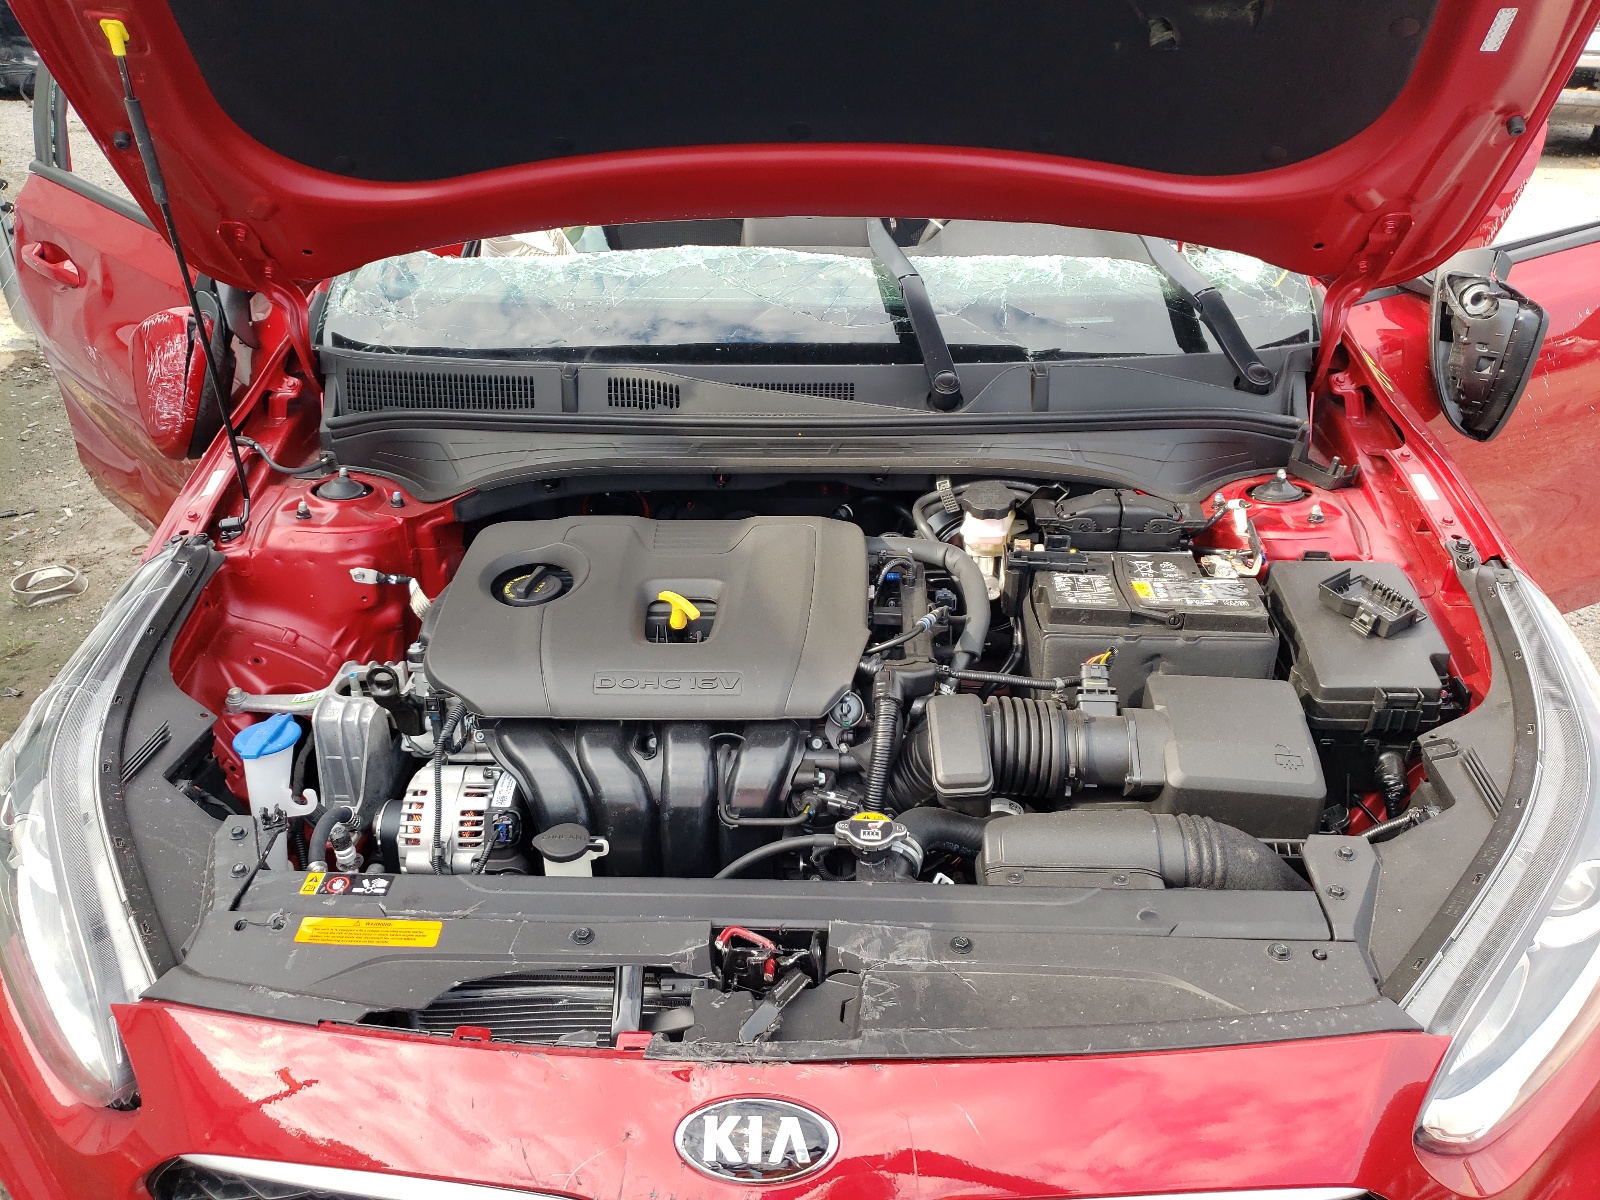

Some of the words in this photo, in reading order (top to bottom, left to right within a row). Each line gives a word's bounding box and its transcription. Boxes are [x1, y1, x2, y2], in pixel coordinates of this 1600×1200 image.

[595, 676, 682, 690] DOHC
[689, 676, 740, 690] 16V
[703, 1115, 811, 1164] KIA
